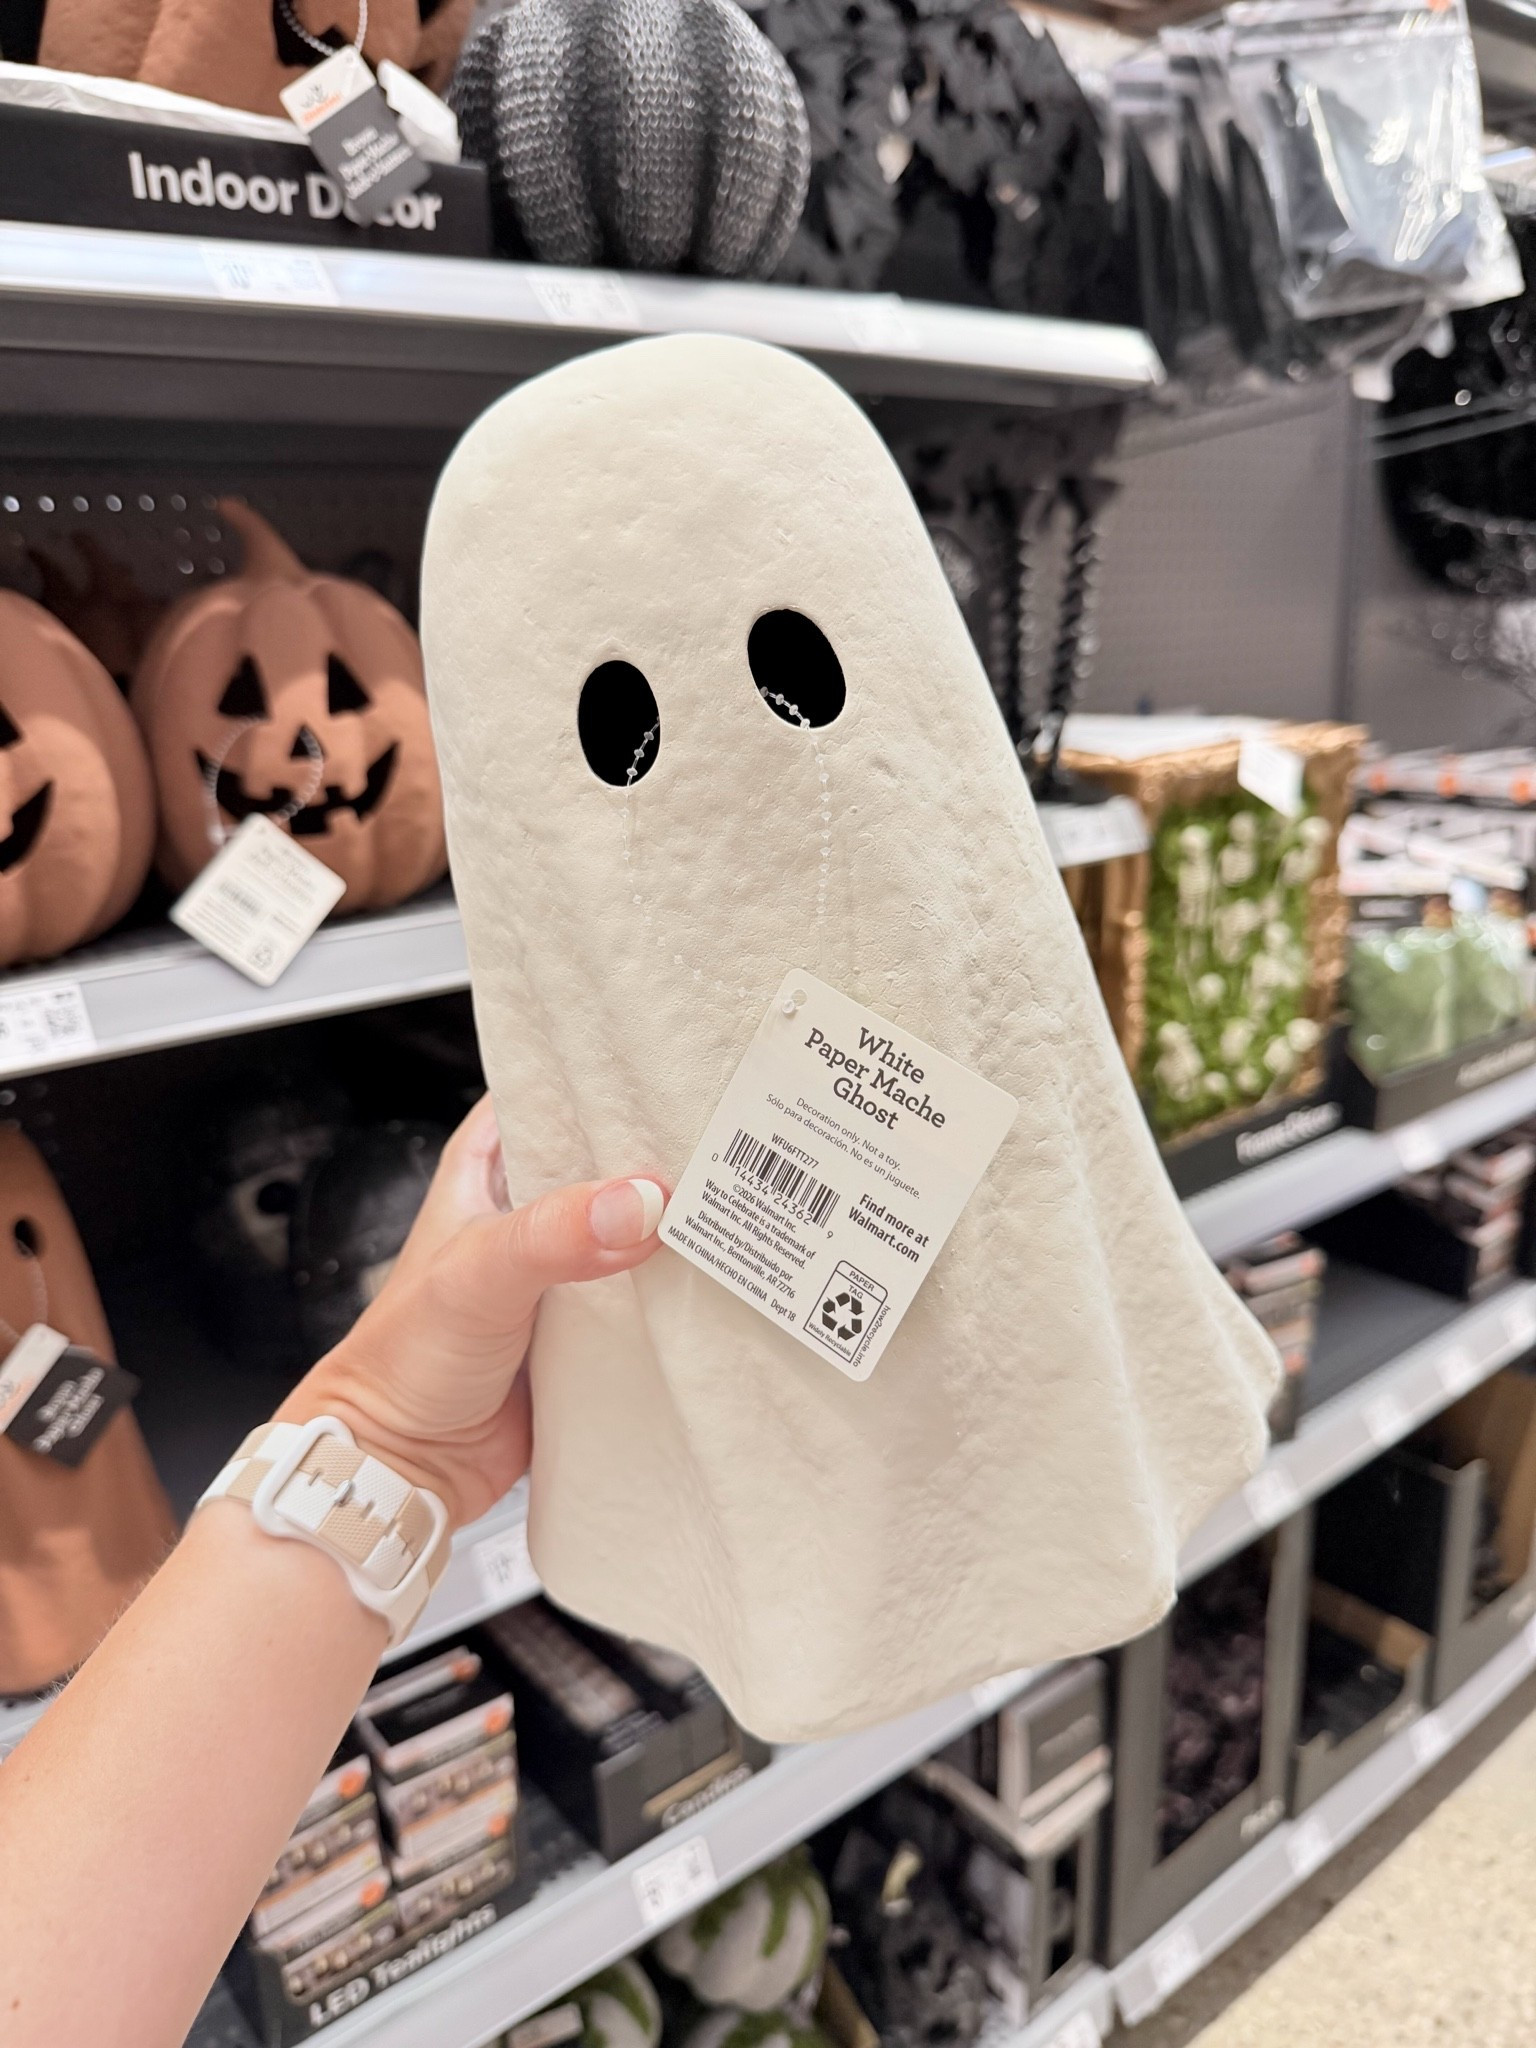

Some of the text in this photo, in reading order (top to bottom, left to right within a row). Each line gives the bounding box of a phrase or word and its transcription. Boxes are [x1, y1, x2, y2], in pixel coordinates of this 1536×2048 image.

[129, 150, 300, 217] Indoor
[307, 173, 443, 231] Dor
[803, 1026, 946, 1129] Paper Mache
[858, 1026, 925, 1085] White
[796, 1097, 901, 1171] Decoration only. Not a toy.
[833, 1076, 899, 1131] Ghost
[766, 1093, 920, 1200] Sólo para decoración. No es un juguete.
[771, 1132, 820, 1169] WFU6FTT277
[705, 1178, 817, 1260] Way to Celebrate is a trademark of
[711, 1152, 834, 1239] 0 14434 24362 9
[732, 1183, 797, 1234] ©2026 Walmart Inc.
[858, 1193, 930, 1248] Find more at
[685, 1214, 797, 1299] Walmart Inc., Bentonville, AR 72716
[697, 1209, 794, 1282] Distributed by/Distribuido por
[701, 1190, 807, 1270] Walmart Inc. All Rights Reserved.
[848, 1205, 920, 1264] Walmart.com
[667, 1225, 768, 1302] MADE IN CHINA/HECHO EN CHINA
[848, 1270, 875, 1292] PAPER
[848, 1284, 864, 1300] TAG
[770, 1298, 797, 1322] Dept 18
[808, 1321, 852, 1357] Widely Recyclable
[852, 1304, 892, 1368] how2recycle.info
[309, 1975, 368, 2027] LED
